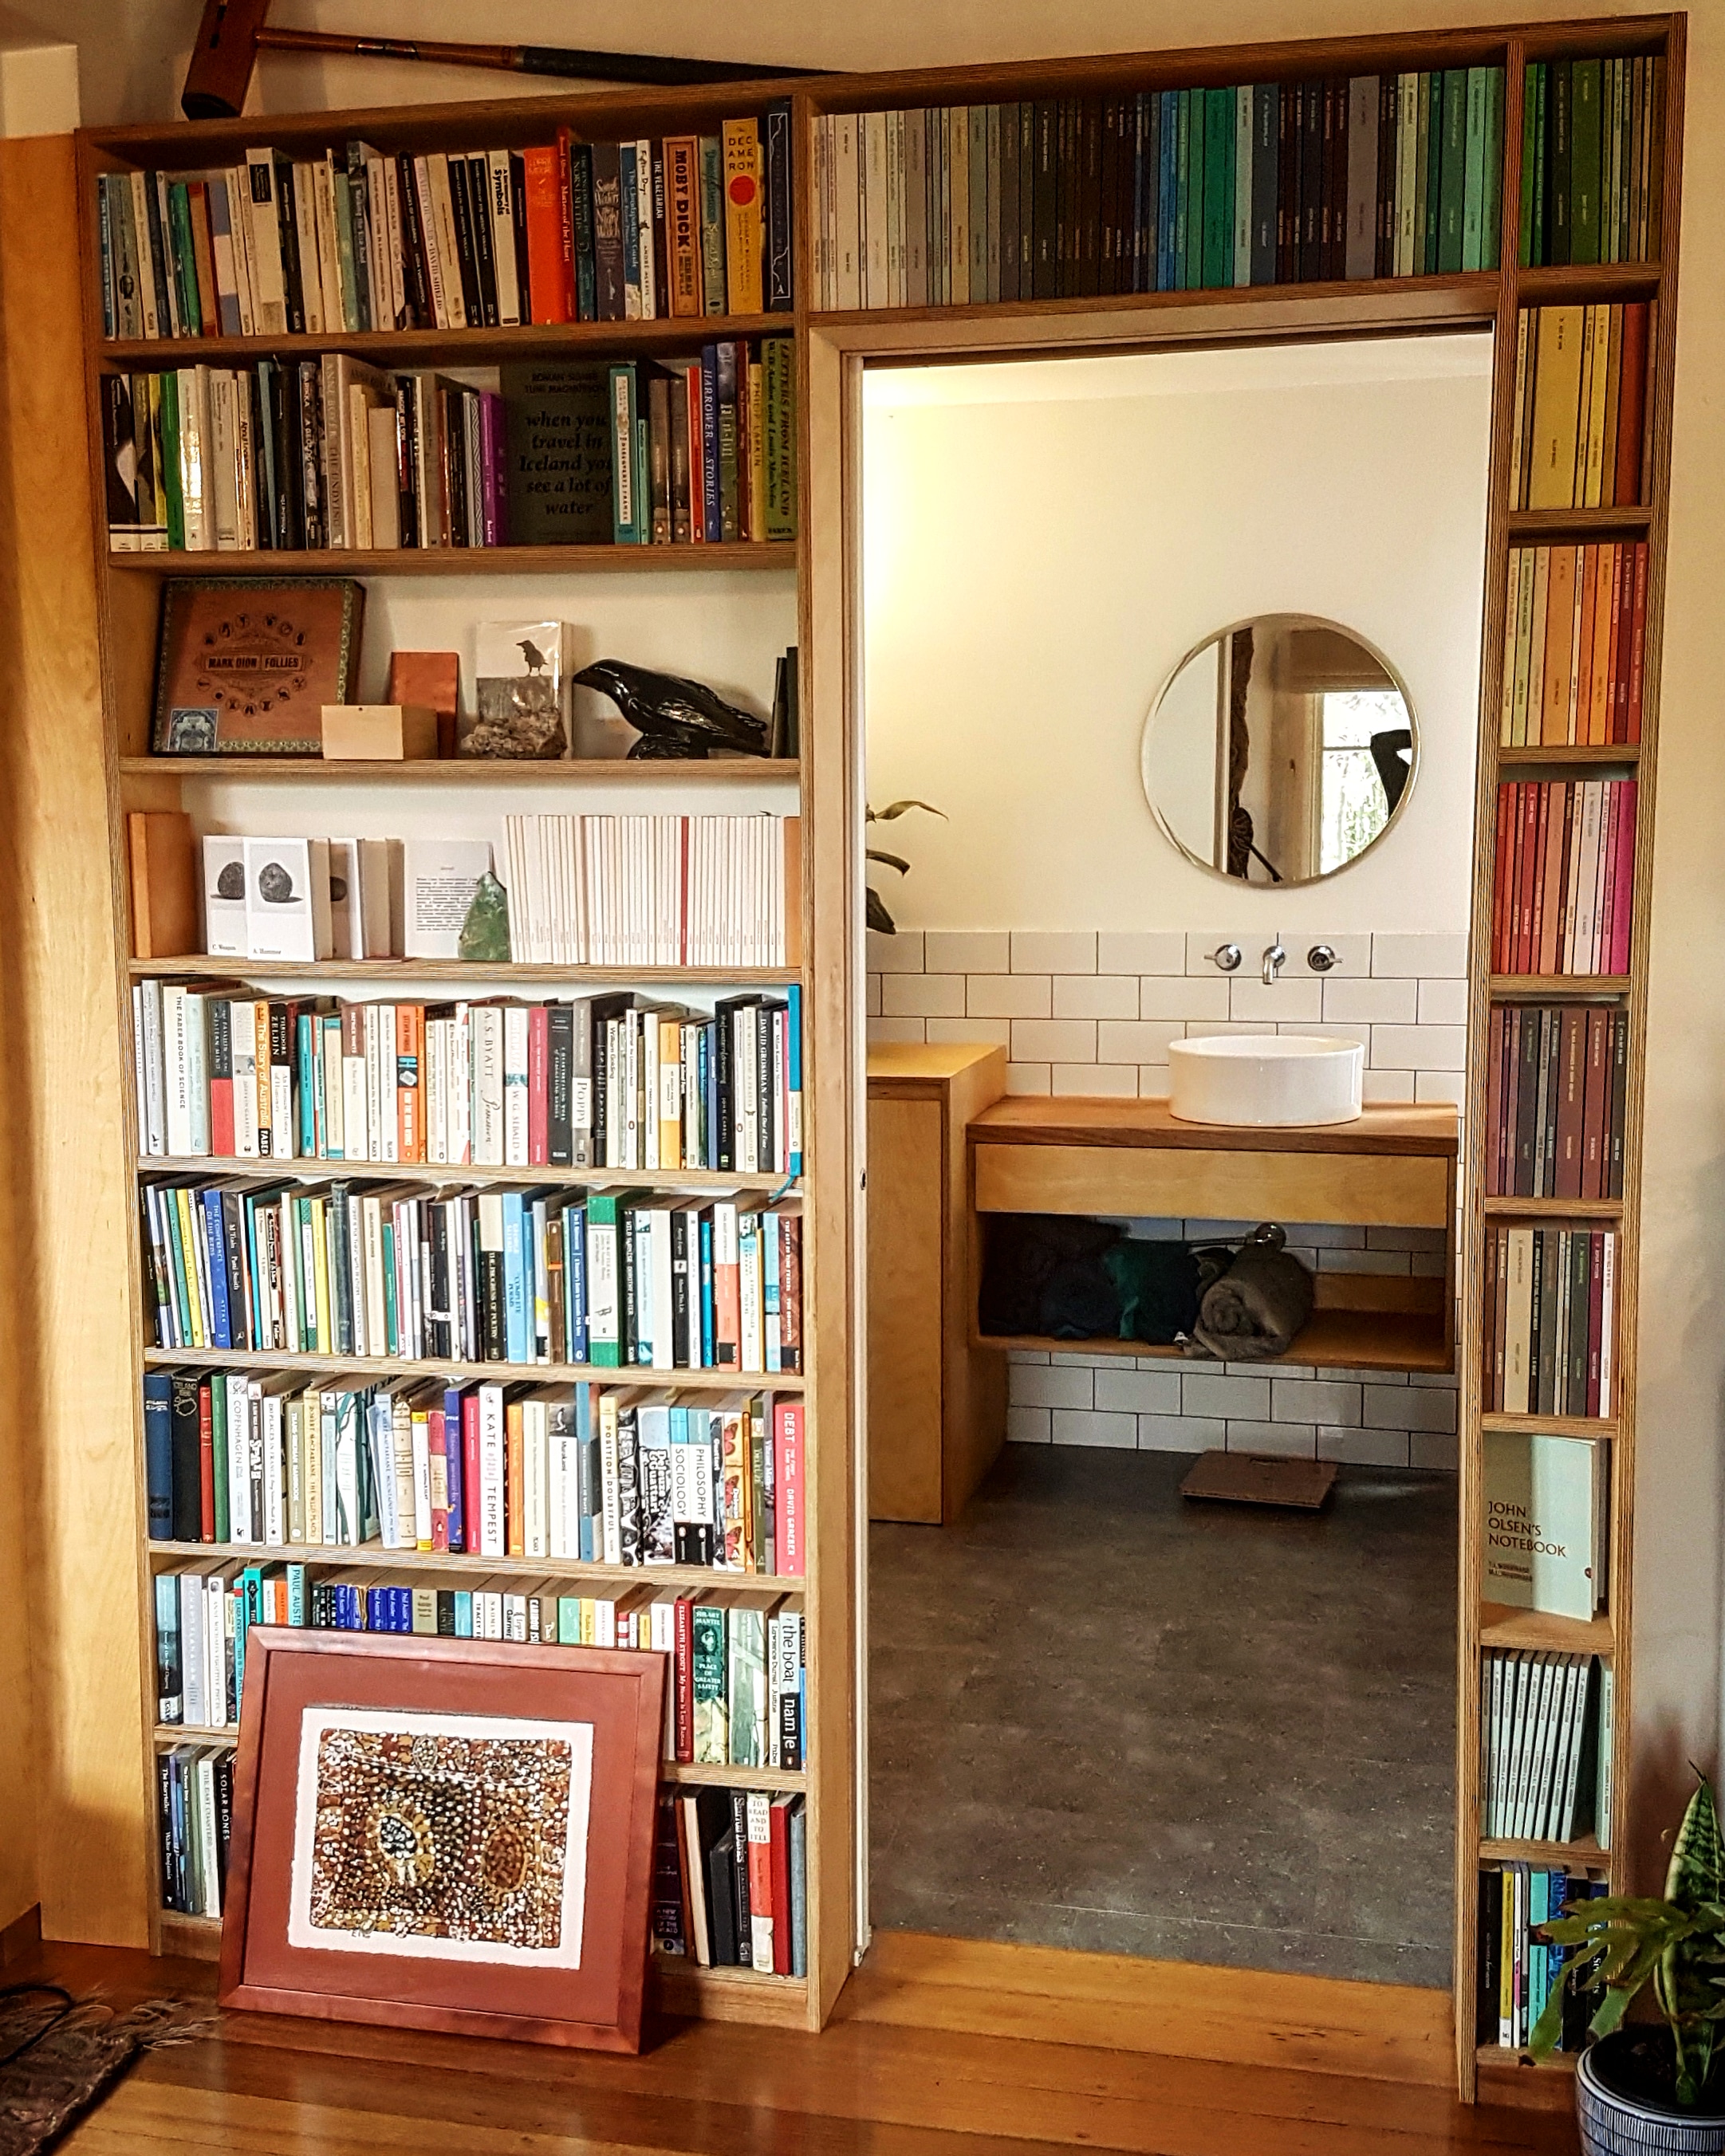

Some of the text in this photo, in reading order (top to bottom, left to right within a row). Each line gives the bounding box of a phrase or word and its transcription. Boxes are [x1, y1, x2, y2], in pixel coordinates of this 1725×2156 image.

[728, 136, 753, 147] DEC
[728, 148, 754, 157] AME
[729, 161, 754, 171] RON
[494, 169, 505, 215] Symbols
[655, 176, 664, 218] VEGETARIAN
[675, 150, 690, 246] MOBY DICK
[428, 248, 439, 274] DAVID
[433, 277, 443, 310] SHIELDS
[526, 411, 606, 431] when you
[781, 344, 790, 516] LETTERS FROM ICELAND
[532, 434, 601, 449] travel in
[704, 369, 715, 506] HARROWER STORIES
[520, 454, 581, 472] Iceland
[527, 480, 551, 493] see
[554, 481, 564, 493] a
[569, 478, 591, 493] lot
[545, 502, 593, 514] water
[209, 657, 298, 667] MARK DION FOLLIES
[258, 1024, 266, 1041] The
[258, 1044, 267, 1068] Story
[259, 1072, 268, 1081] of
[577, 1082, 587, 1124] POPPY
[785, 1412, 795, 1442] DEBT
[486, 1414, 496, 1544] KATE TEMPEST
[658, 1450, 667, 1497] Deleuze
[675, 1448, 685, 1516] SOCIOLOGY
[696, 1449, 706, 1517] PHILOSOPHY
[1489, 1501, 1526, 1517] JOHN
[1488, 1517, 1542, 1536] OLSEN'S
[1489, 1533, 1568, 1558] NOTEBOOK
[783, 1625, 797, 1749] the boat nam le
[735, 1835, 746, 1863] Davies
